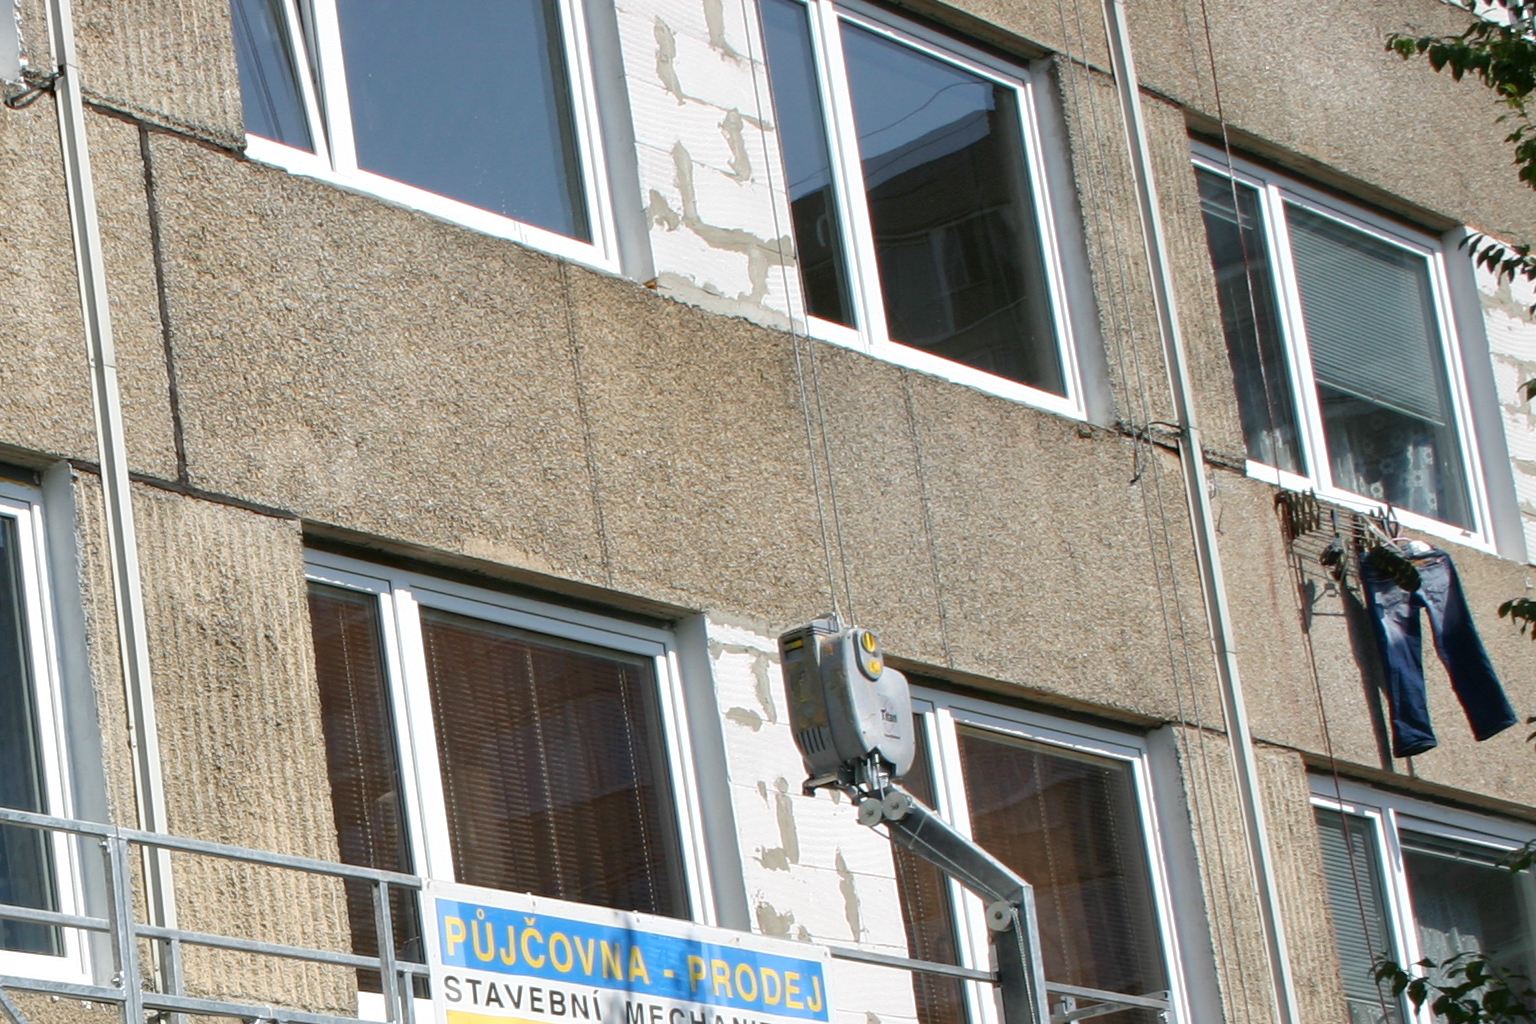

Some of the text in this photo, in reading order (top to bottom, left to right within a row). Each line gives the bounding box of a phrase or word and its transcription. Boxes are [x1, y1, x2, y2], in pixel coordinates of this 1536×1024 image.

[444, 908, 822, 1012] PŮJČOVNA - PRODEJ
[444, 975, 602, 1021] STAVEBNÍ
